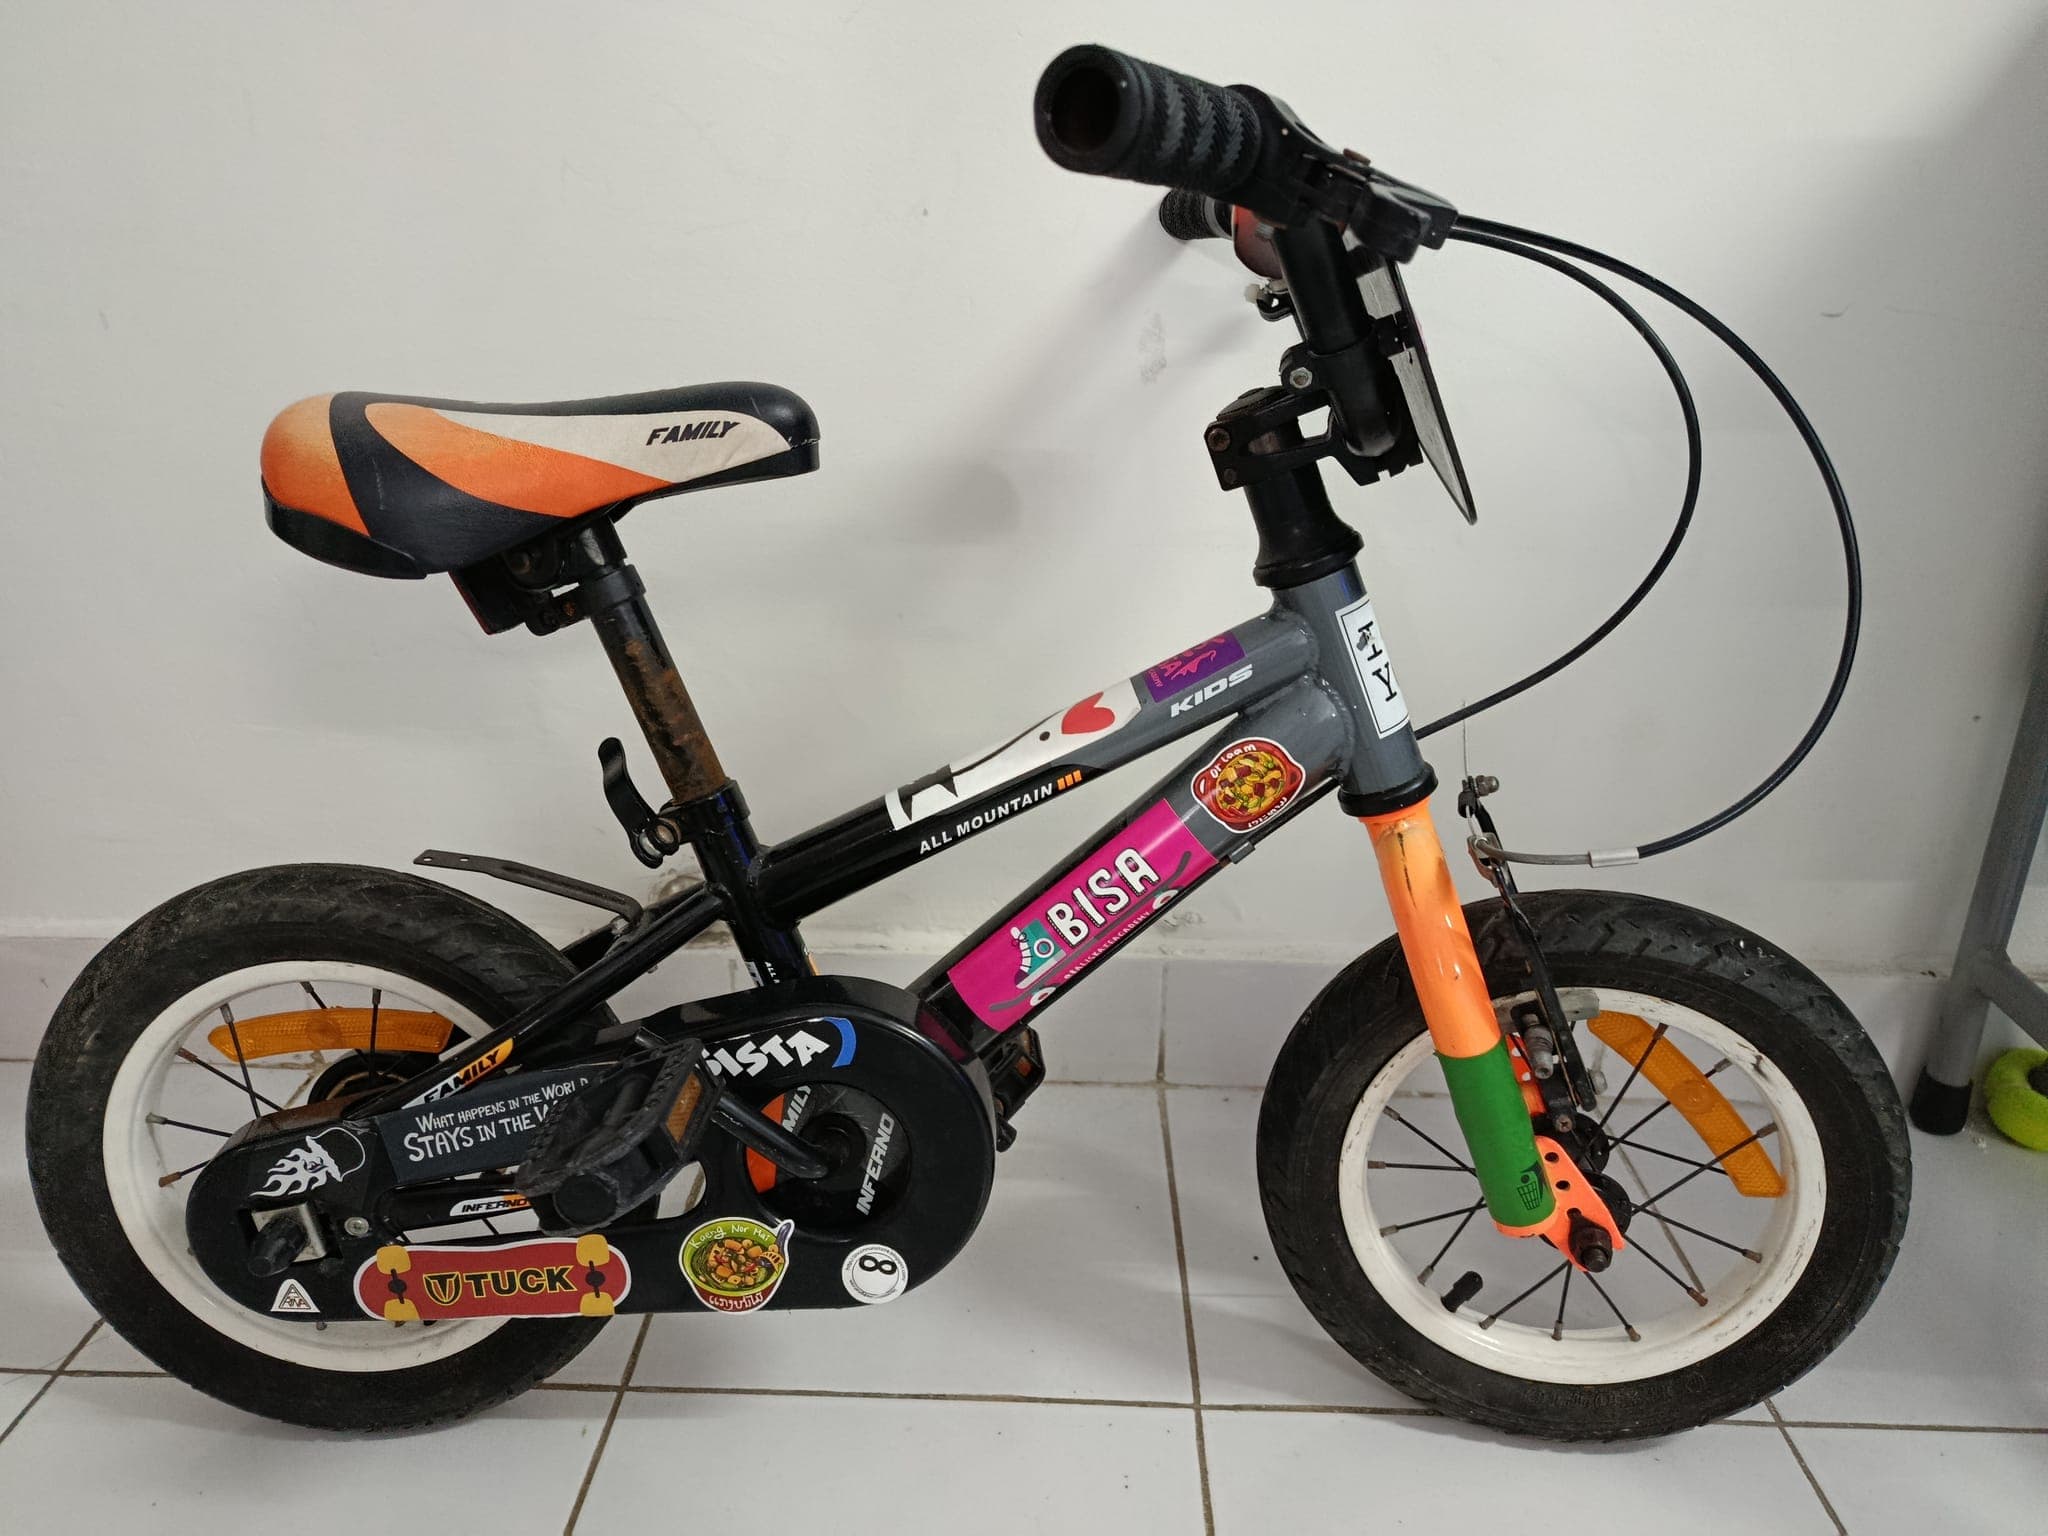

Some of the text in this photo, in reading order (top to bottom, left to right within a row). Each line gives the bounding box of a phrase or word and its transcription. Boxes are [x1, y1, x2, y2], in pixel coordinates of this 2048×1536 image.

[646, 420, 740, 446] FAMILY
[1170, 663, 1253, 718] KIDS
[919, 782, 1053, 855] ALL MOUNTAIN
[1046, 848, 1160, 947] BISA
[424, 1050, 500, 1104] FAMILY
[403, 1112, 537, 1163] STAYS IN THE
[415, 1112, 455, 1134] WHAT
[458, 1101, 506, 1123] HAPPENS
[509, 1097, 520, 1111] IN
[521, 1092, 543, 1106] THE
[856, 1112, 896, 1216] INFERNO
[731, 1223, 750, 1234] Nor
[752, 1227, 771, 1242] Mai
[463, 1264, 579, 1299] TUCK
